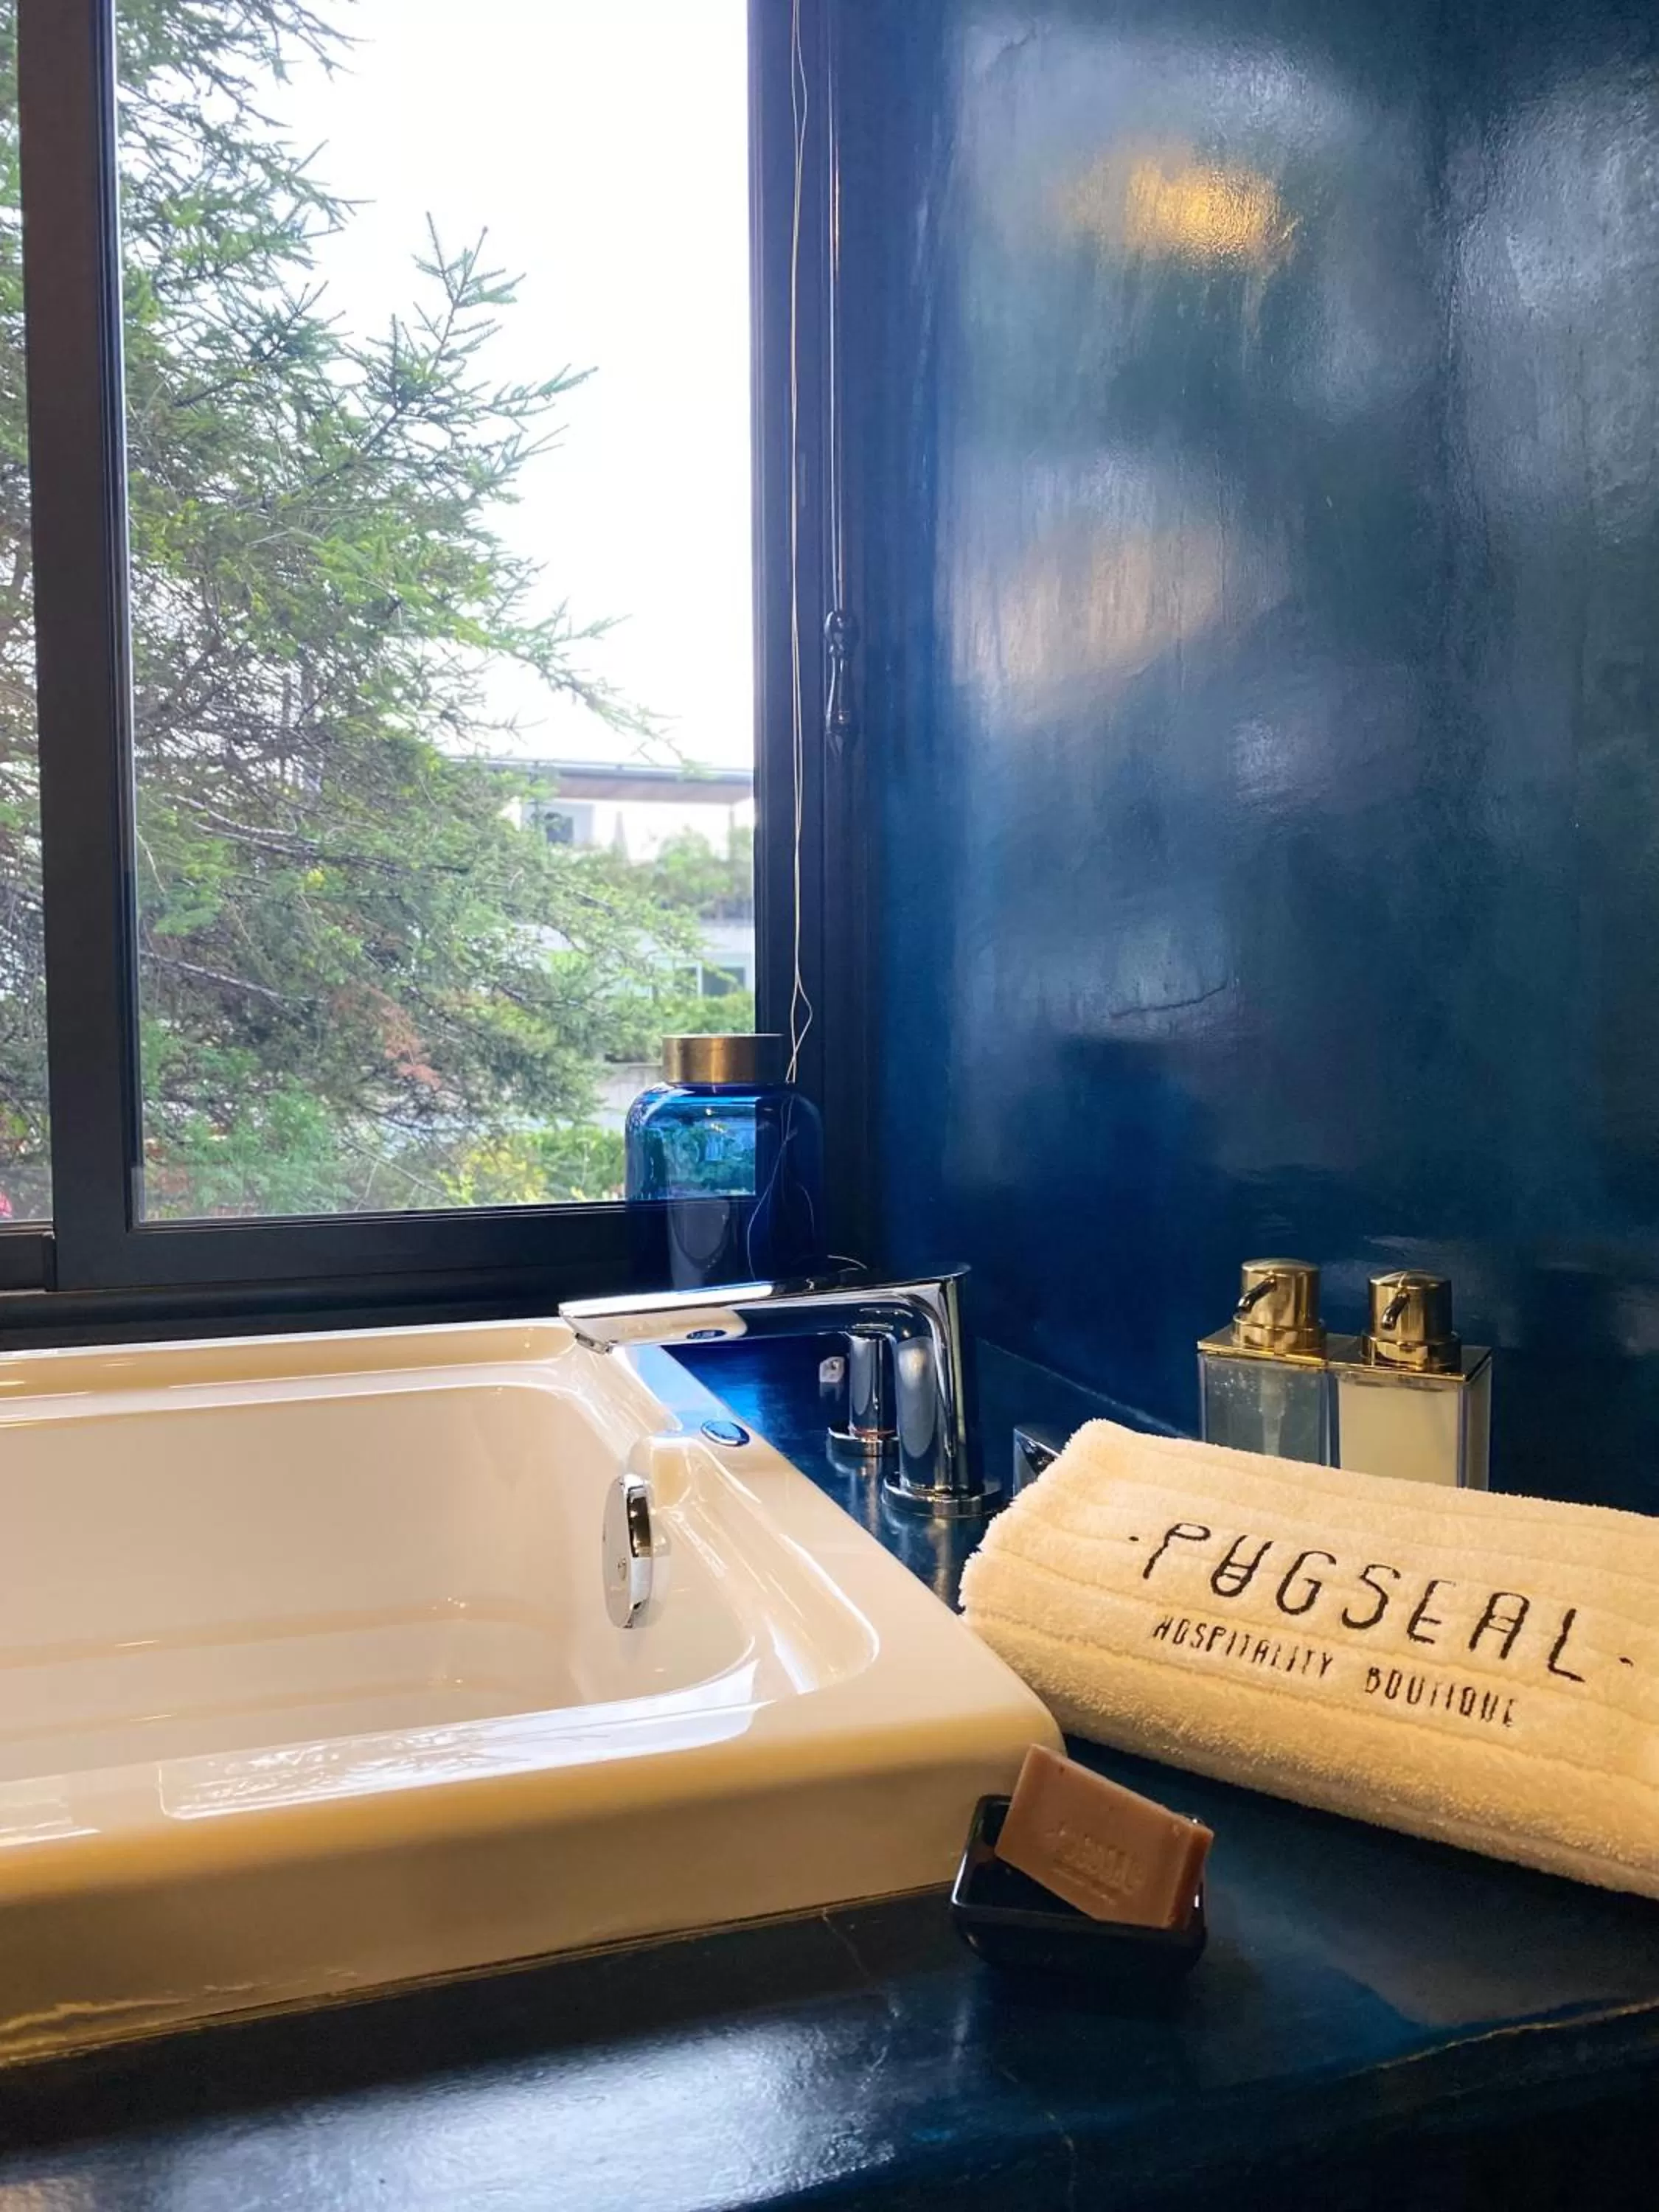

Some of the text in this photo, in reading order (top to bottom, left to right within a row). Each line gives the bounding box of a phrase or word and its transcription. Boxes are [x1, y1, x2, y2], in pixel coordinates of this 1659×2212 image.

[1143, 1523, 1585, 1683] PUGSEAL
[1152, 1615, 1516, 1727] HOSPITALITY BOUTIQUE
